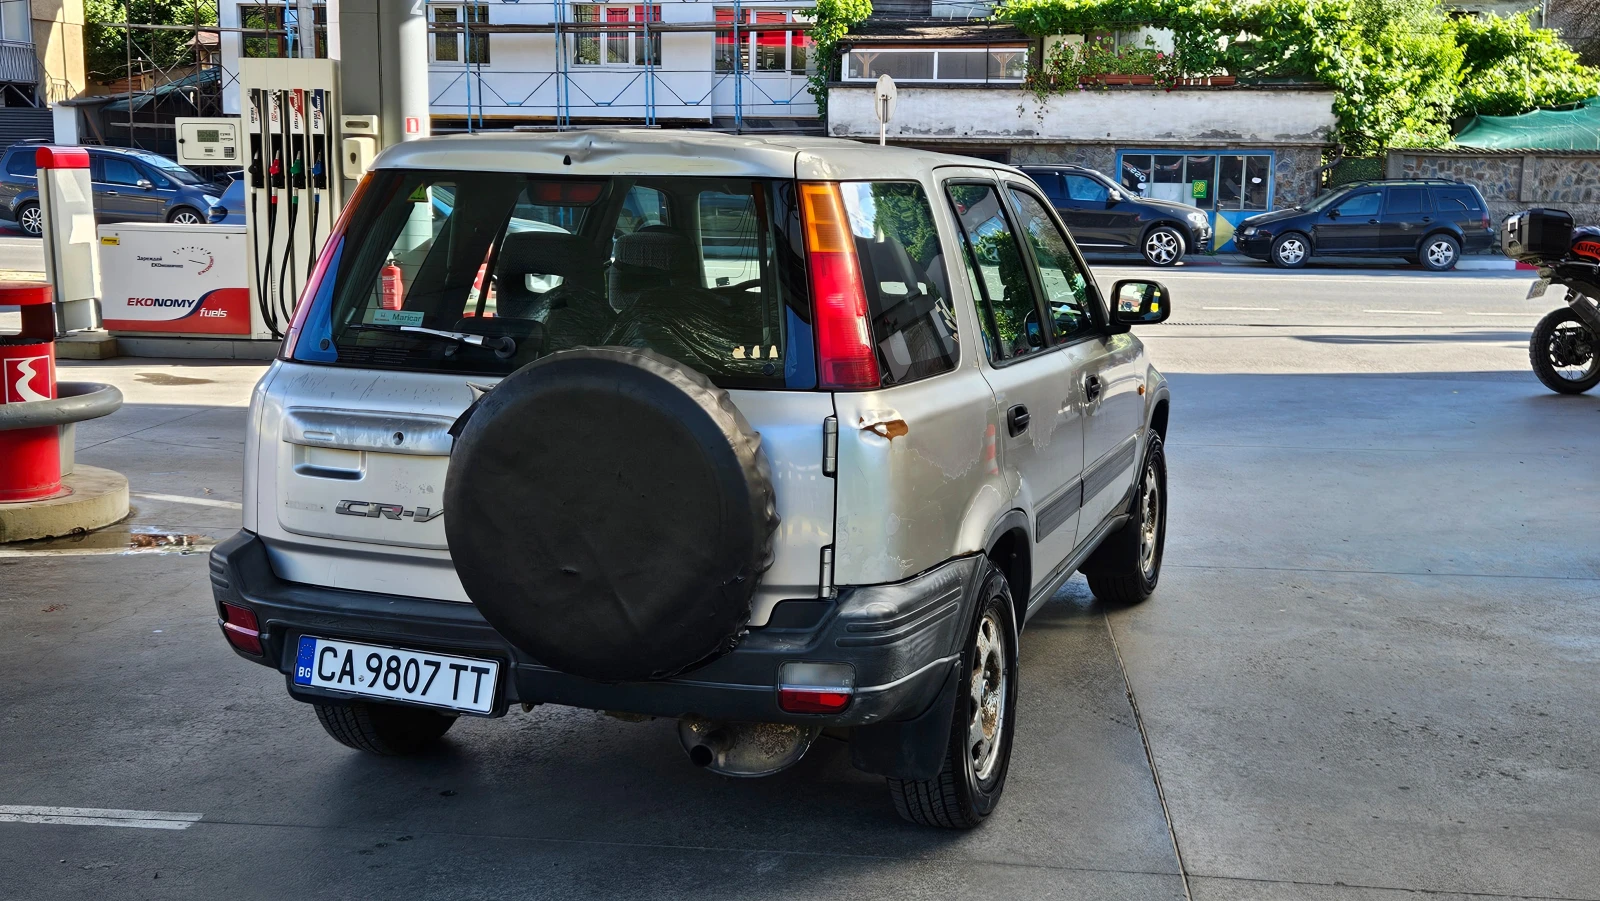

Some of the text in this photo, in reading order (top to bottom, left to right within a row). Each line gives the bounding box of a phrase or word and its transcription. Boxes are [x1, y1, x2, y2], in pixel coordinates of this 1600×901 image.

[127, 297, 195, 308] EKONOMY
[200, 307, 227, 318] fuels
[392, 313, 422, 322] Maricar
[298, 666, 311, 679] BG
[317, 646, 490, 704] CA 9807 TT
